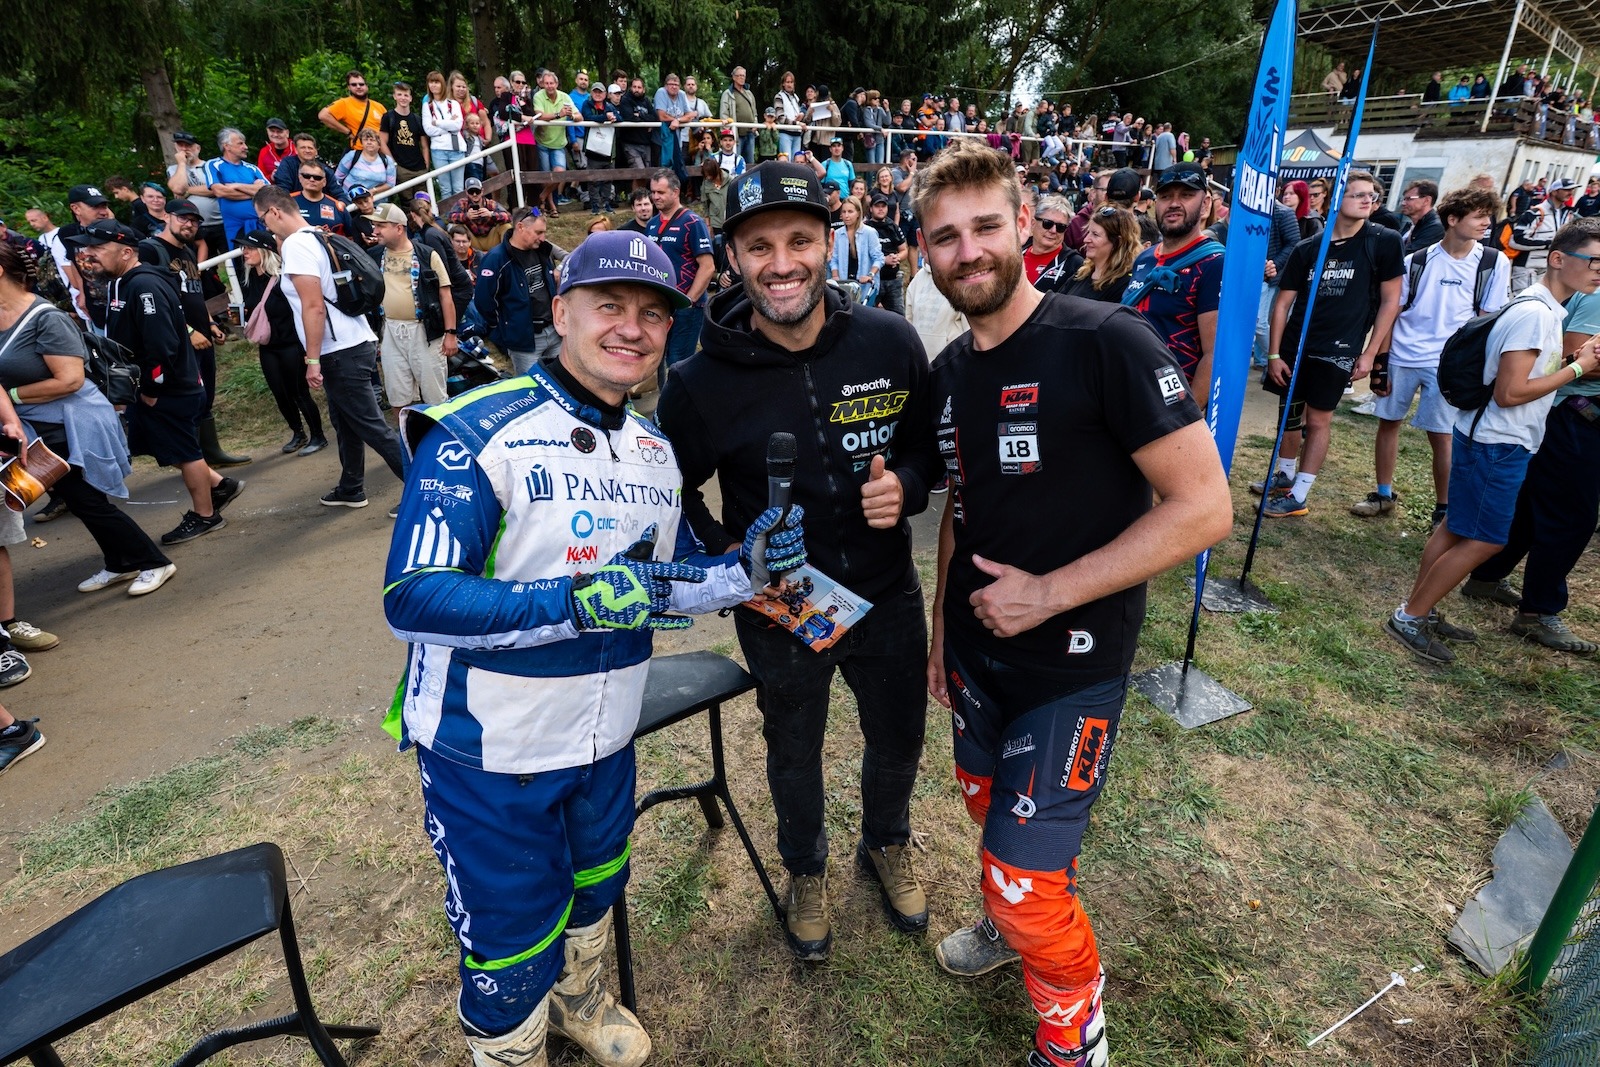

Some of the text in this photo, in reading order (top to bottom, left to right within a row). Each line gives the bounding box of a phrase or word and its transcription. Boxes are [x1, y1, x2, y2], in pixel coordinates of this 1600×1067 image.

[783, 184, 808, 196] orion
[598, 257, 668, 283] PANATTONI
[532, 373, 575, 412] NAZRAN
[1164, 377, 1181, 393] 18
[488, 391, 539, 424] PANATTONI
[1003, 390, 1035, 404] KTM
[504, 438, 570, 449] NAZRAN
[1005, 440, 1031, 459] 18
[424, 494, 458, 509] READY
[561, 472, 681, 509] PANATTONI
[1060, 715, 1085, 788] CAJDASROT.CZ
[1077, 725, 1104, 784] KTM
